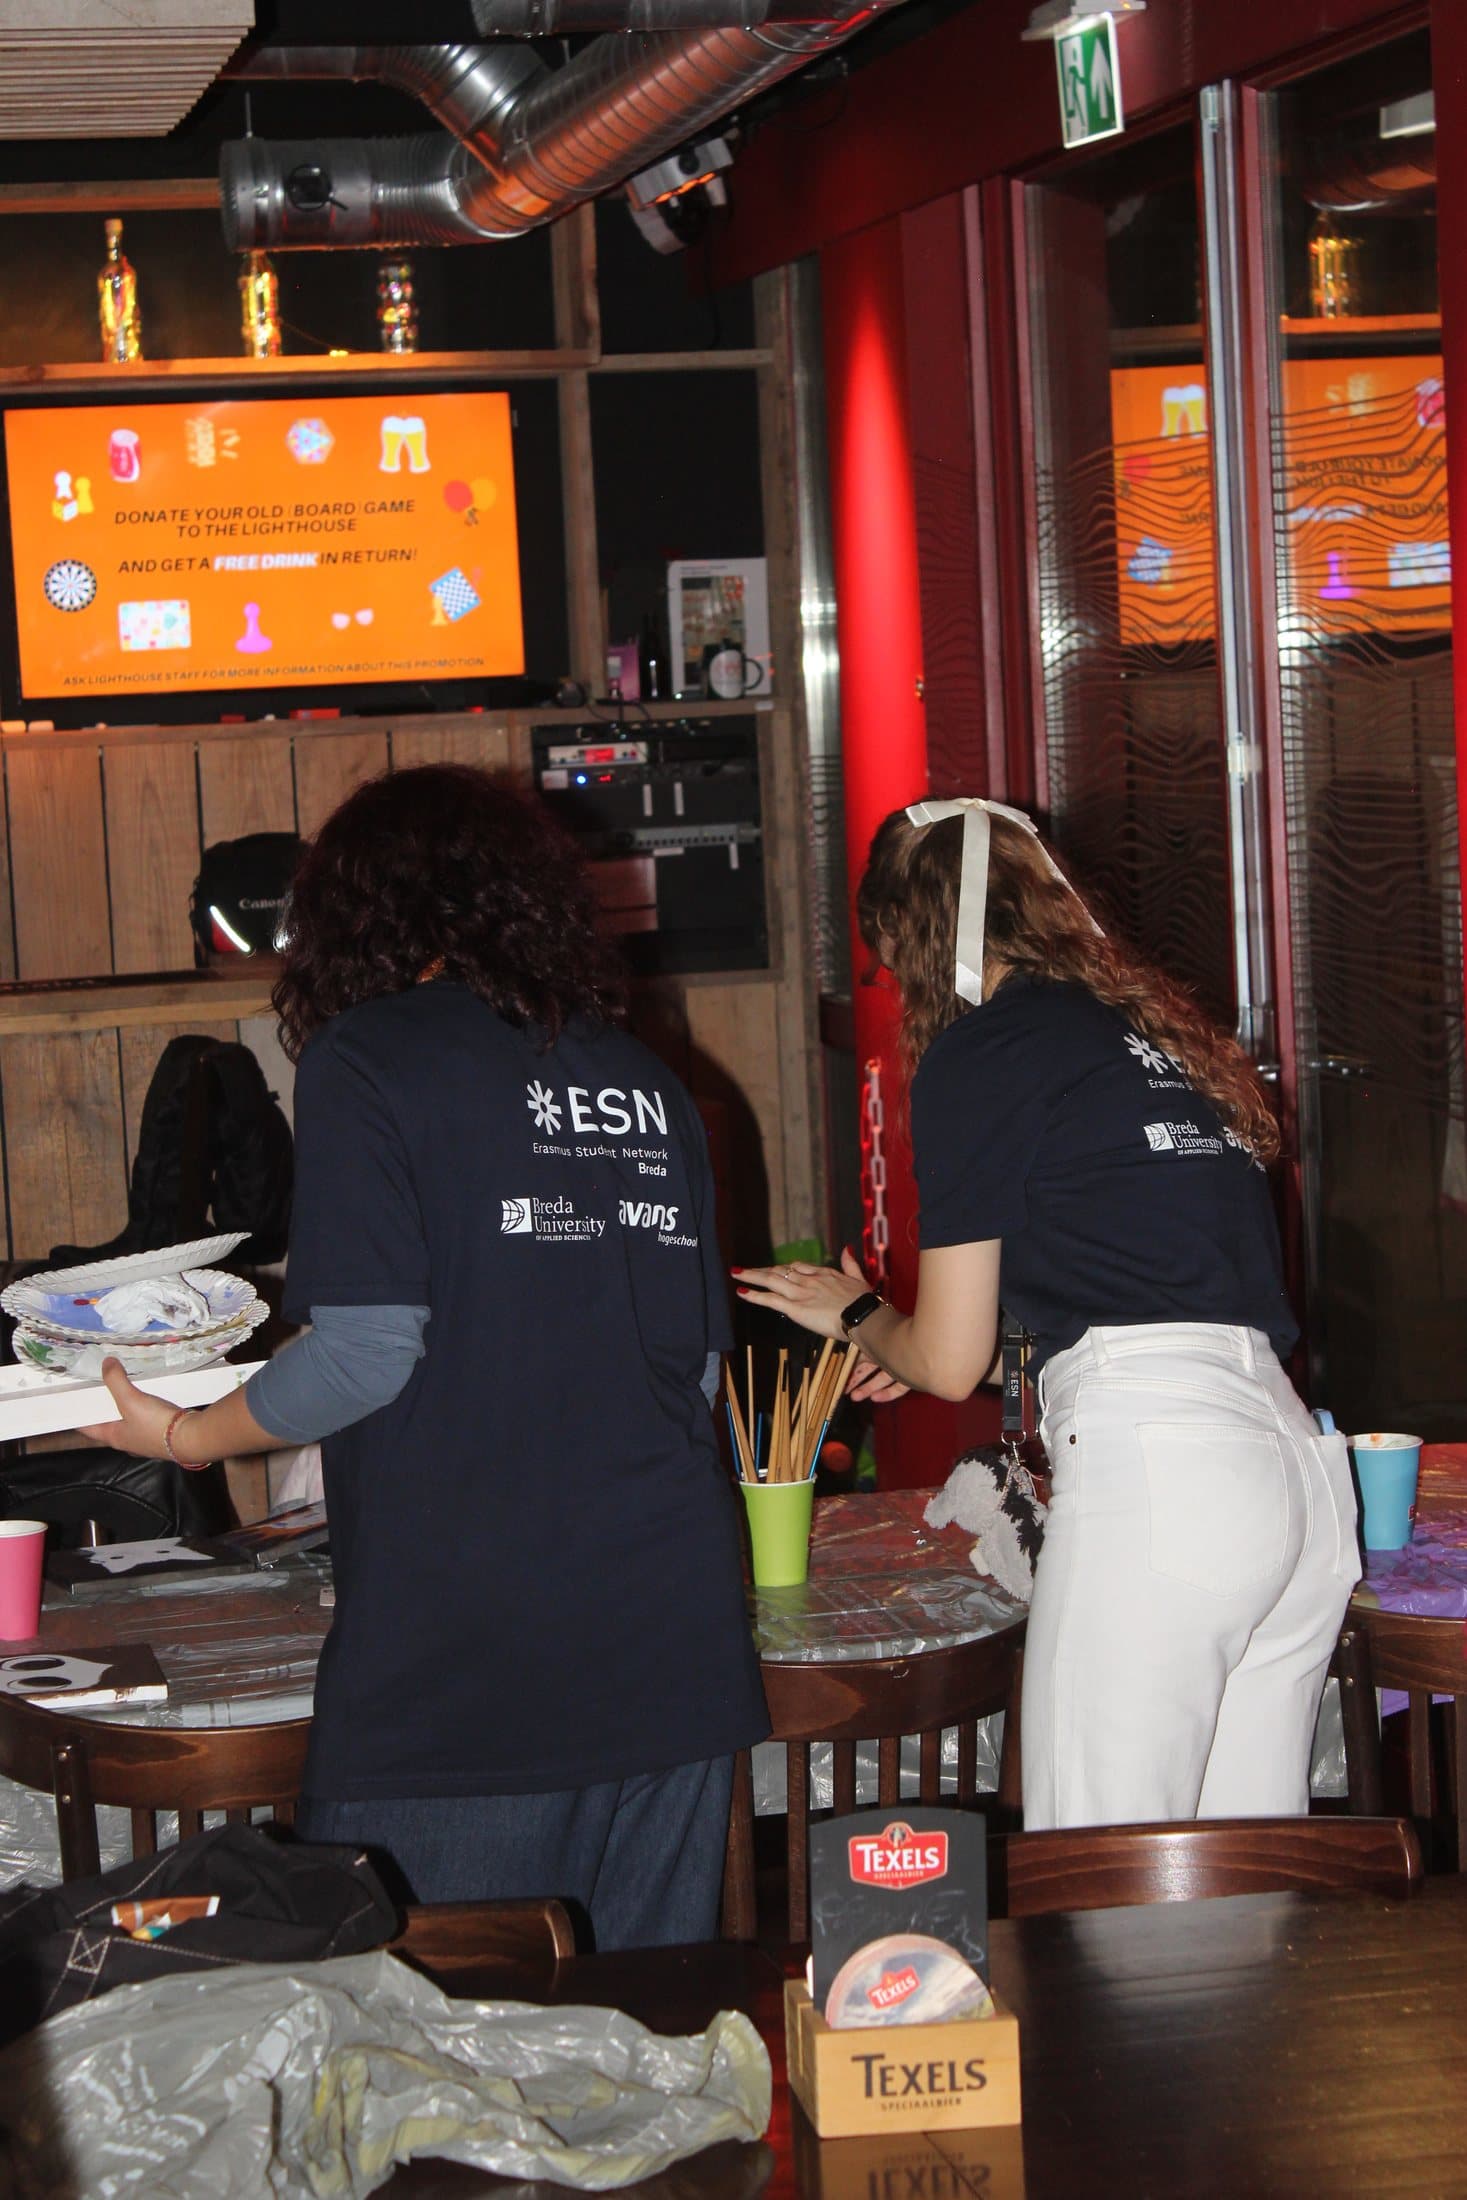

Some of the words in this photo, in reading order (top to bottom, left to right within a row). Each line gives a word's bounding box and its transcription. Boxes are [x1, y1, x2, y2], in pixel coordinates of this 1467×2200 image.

[114, 508, 189, 524] DONATE
[194, 506, 243, 521] YOUR
[246, 504, 284, 519] OLD
[364, 499, 416, 514] GAME
[177, 524, 200, 538] TO
[205, 523, 237, 537] THE
[242, 518, 357, 536] LIGHTHOUSE
[118, 559, 157, 573] AND
[161, 557, 196, 571] GET
[199, 557, 210, 570] A
[213, 553, 259, 571] FREE
[261, 551, 317, 570] DRINK
[320, 552, 338, 564] IN
[341, 548, 418, 563] RETURN!
[64, 675, 85, 686] ASK
[88, 672, 162, 685] LIGHTHOUSE
[165, 671, 200, 681] STAFF
[202, 669, 225, 679] FOR
[227, 667, 260, 677] MORE
[263, 664, 344, 675] INFORMATION
[347, 661, 386, 673] ABOUT
[388, 659, 413, 671] THIS
[567, 1086, 668, 1135] ESN
[1166, 1119, 1200, 1135] Breda
[533, 1142, 572, 1157] Erasmus
[575, 1145, 617, 1159] Student
[622, 1147, 668, 1160] Network
[1172, 1134, 1223, 1154] University
[638, 1162, 667, 1177] Breda
[532, 1196, 574, 1215] Breda
[618, 1200, 679, 1232] avans
[534, 1216, 606, 1238] University
[657, 1232, 698, 1248] hogeschool
[1010, 1379, 1019, 1397] ESN
